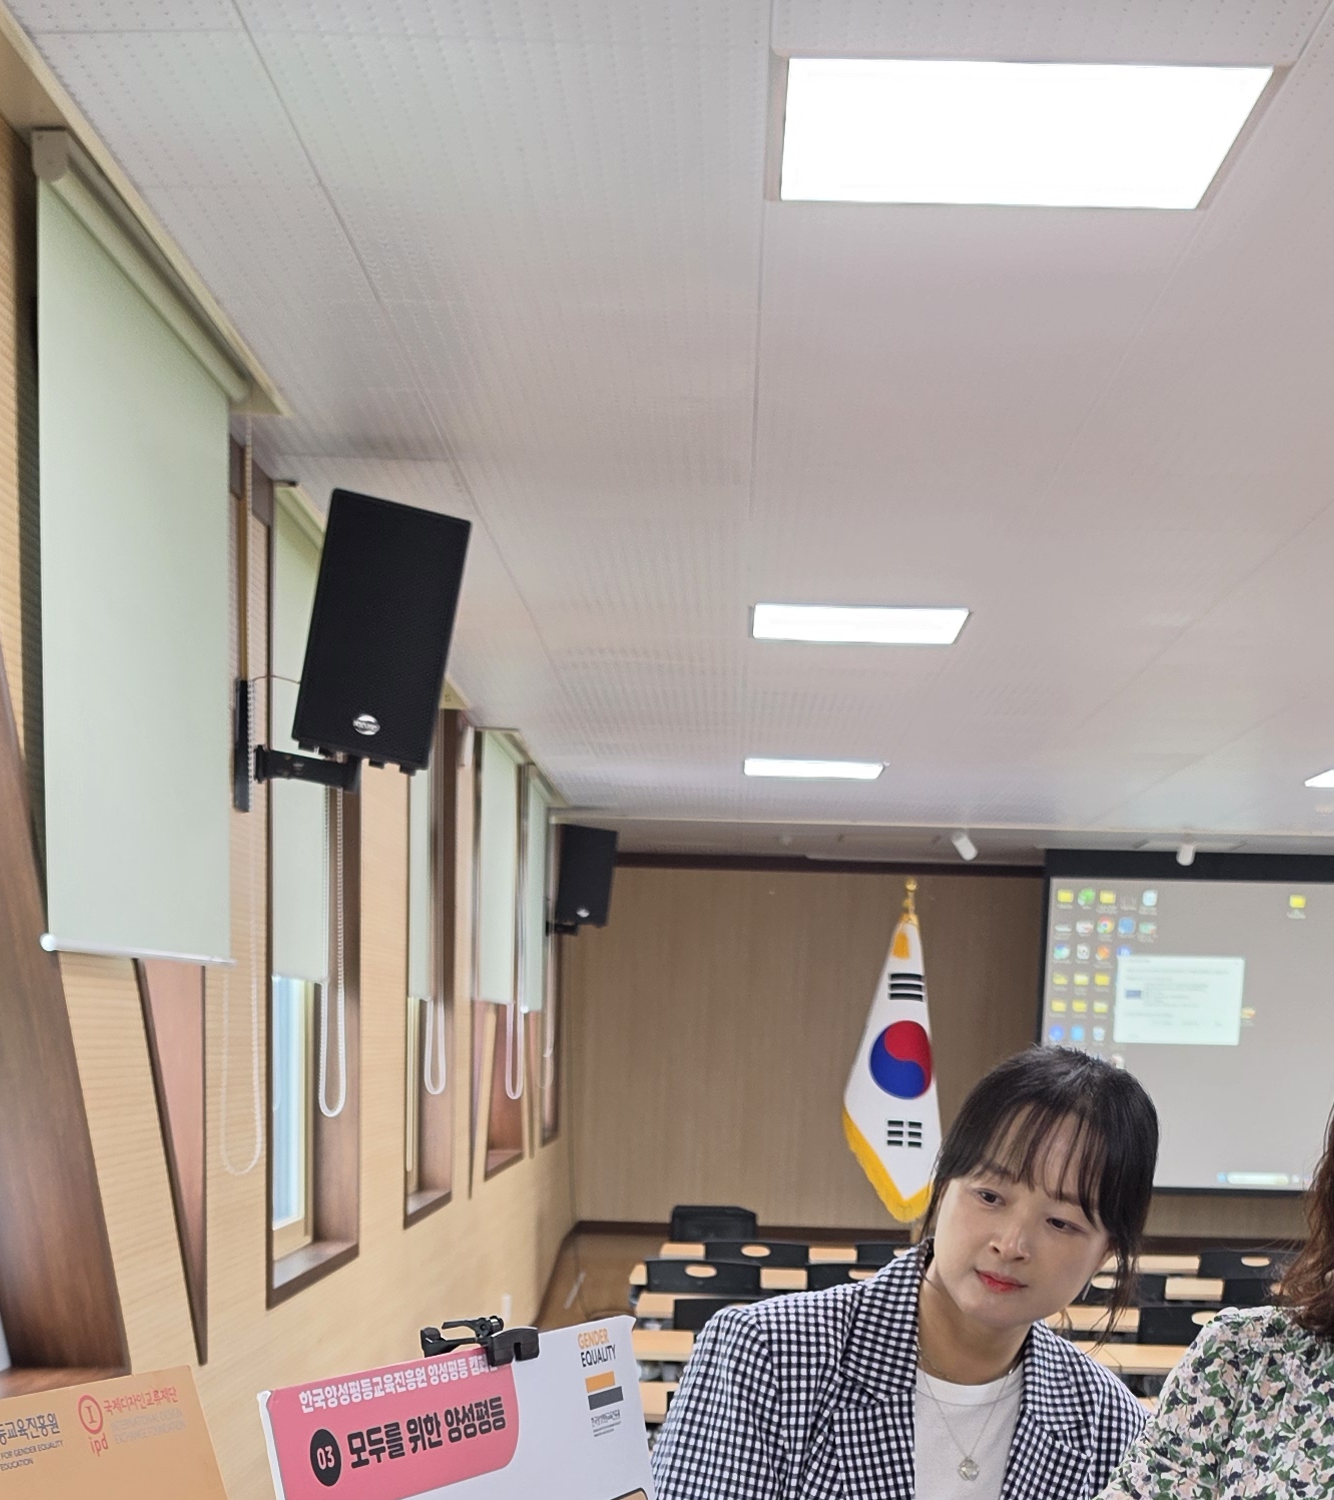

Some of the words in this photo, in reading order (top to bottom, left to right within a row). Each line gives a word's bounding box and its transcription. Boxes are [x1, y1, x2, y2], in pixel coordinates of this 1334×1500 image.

[578, 1328, 609, 1349] GENDER
[580, 1344, 616, 1367] EQUALITY
[298, 1368, 427, 1413] 한국양성평등교육진흥원
[428, 1355, 468, 1385] 양성평등
[103, 1386, 178, 1415] 국제디자인교류재단
[88, 1432, 109, 1457] ipd
[316, 1446, 335, 1470] 03
[347, 1422, 405, 1469] 모두를
[406, 1412, 443, 1453] 위한
[444, 1396, 506, 1443] 양성평등
[1, 1451, 13, 1460] FOR
[14, 1445, 37, 1457] GENDER
[38, 1440, 64, 1452] EQUALITY
[1, 1458, 34, 1471] EDUCATION
